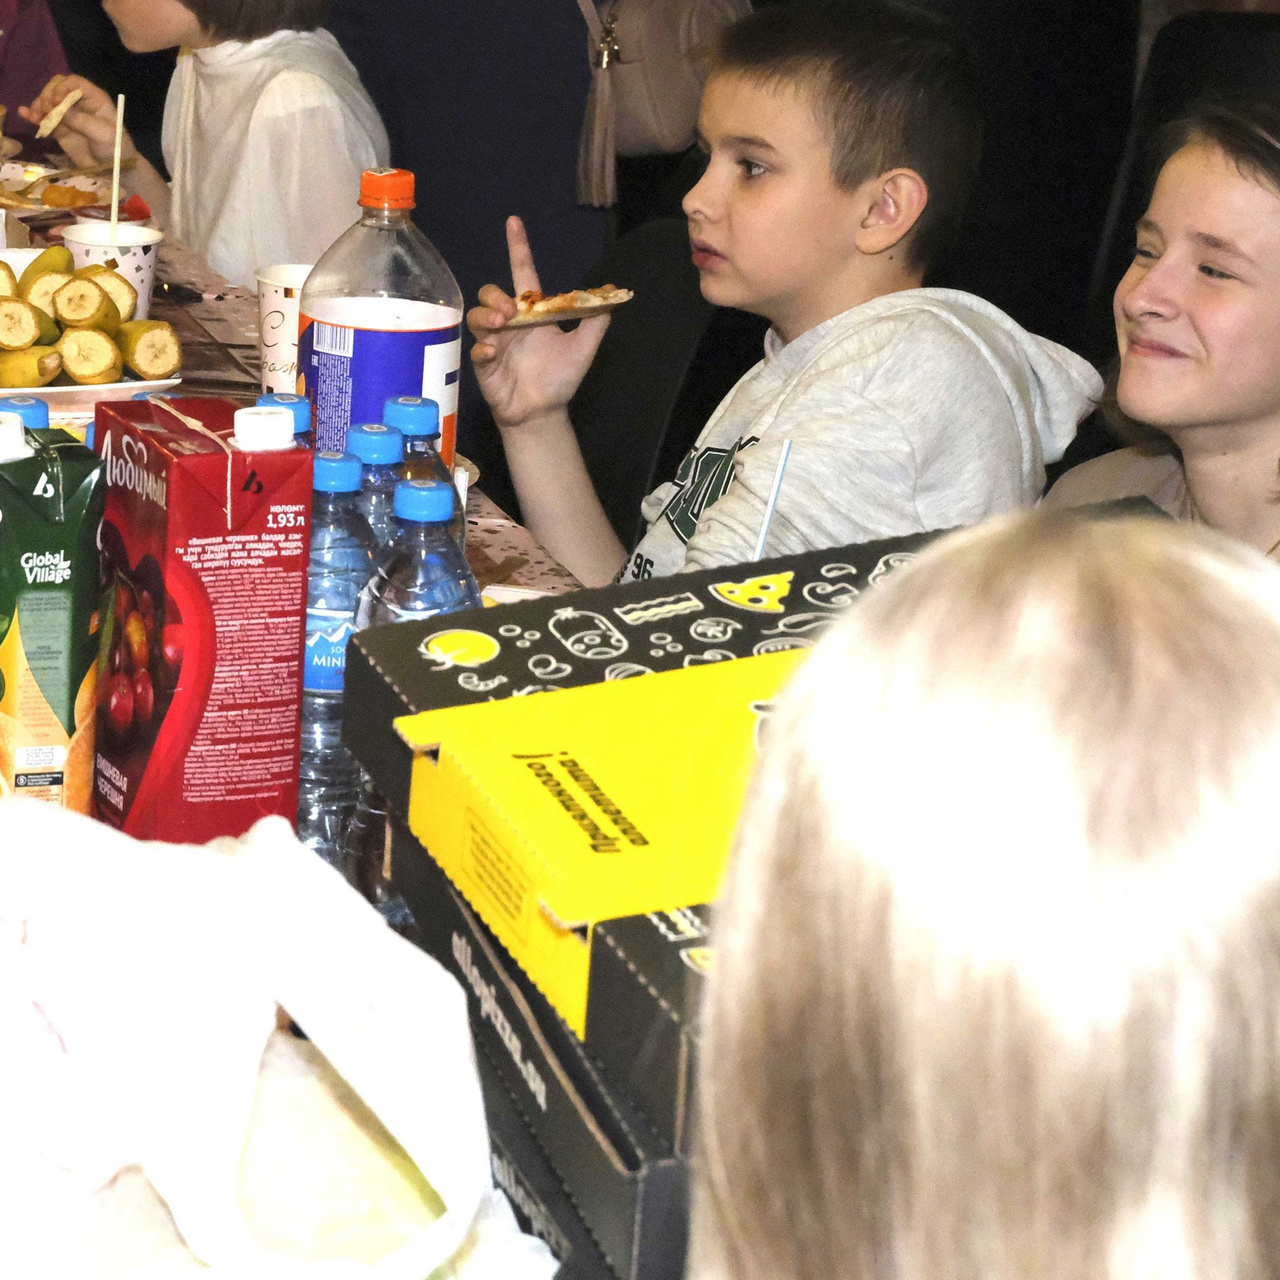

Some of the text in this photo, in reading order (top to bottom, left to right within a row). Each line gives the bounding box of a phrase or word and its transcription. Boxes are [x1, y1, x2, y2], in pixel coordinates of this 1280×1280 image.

[101, 429, 167, 510] Любимый
[267, 513, 295, 529] 1,93
[20, 550, 71, 568] Global
